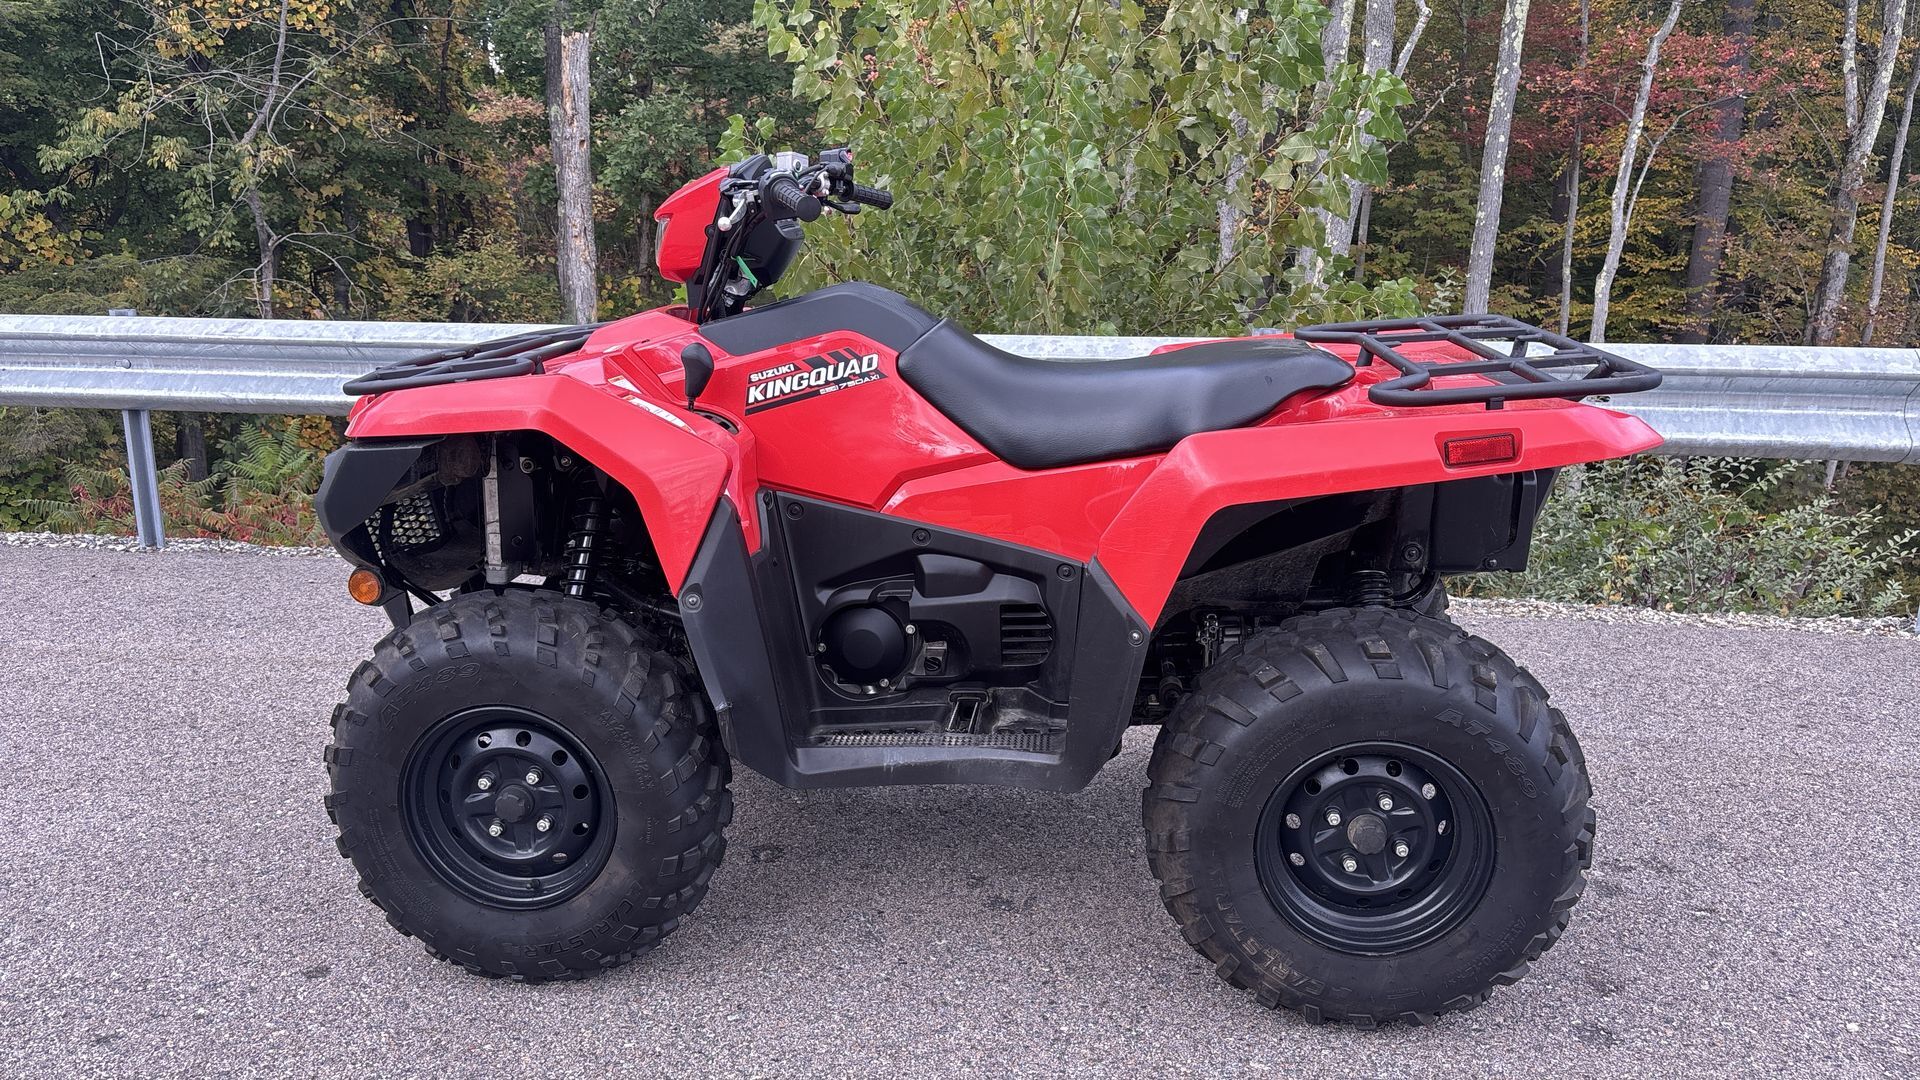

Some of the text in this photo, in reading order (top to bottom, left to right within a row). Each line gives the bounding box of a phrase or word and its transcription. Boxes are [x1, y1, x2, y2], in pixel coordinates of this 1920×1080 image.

[748, 353, 879, 404] KINGQUAD
[750, 363, 795, 382] SUZUKI
[1434, 708, 1537, 799] AT489
[523, 898, 634, 958] CARLSTAR
[1216, 893, 1326, 995] CARLSTAR
